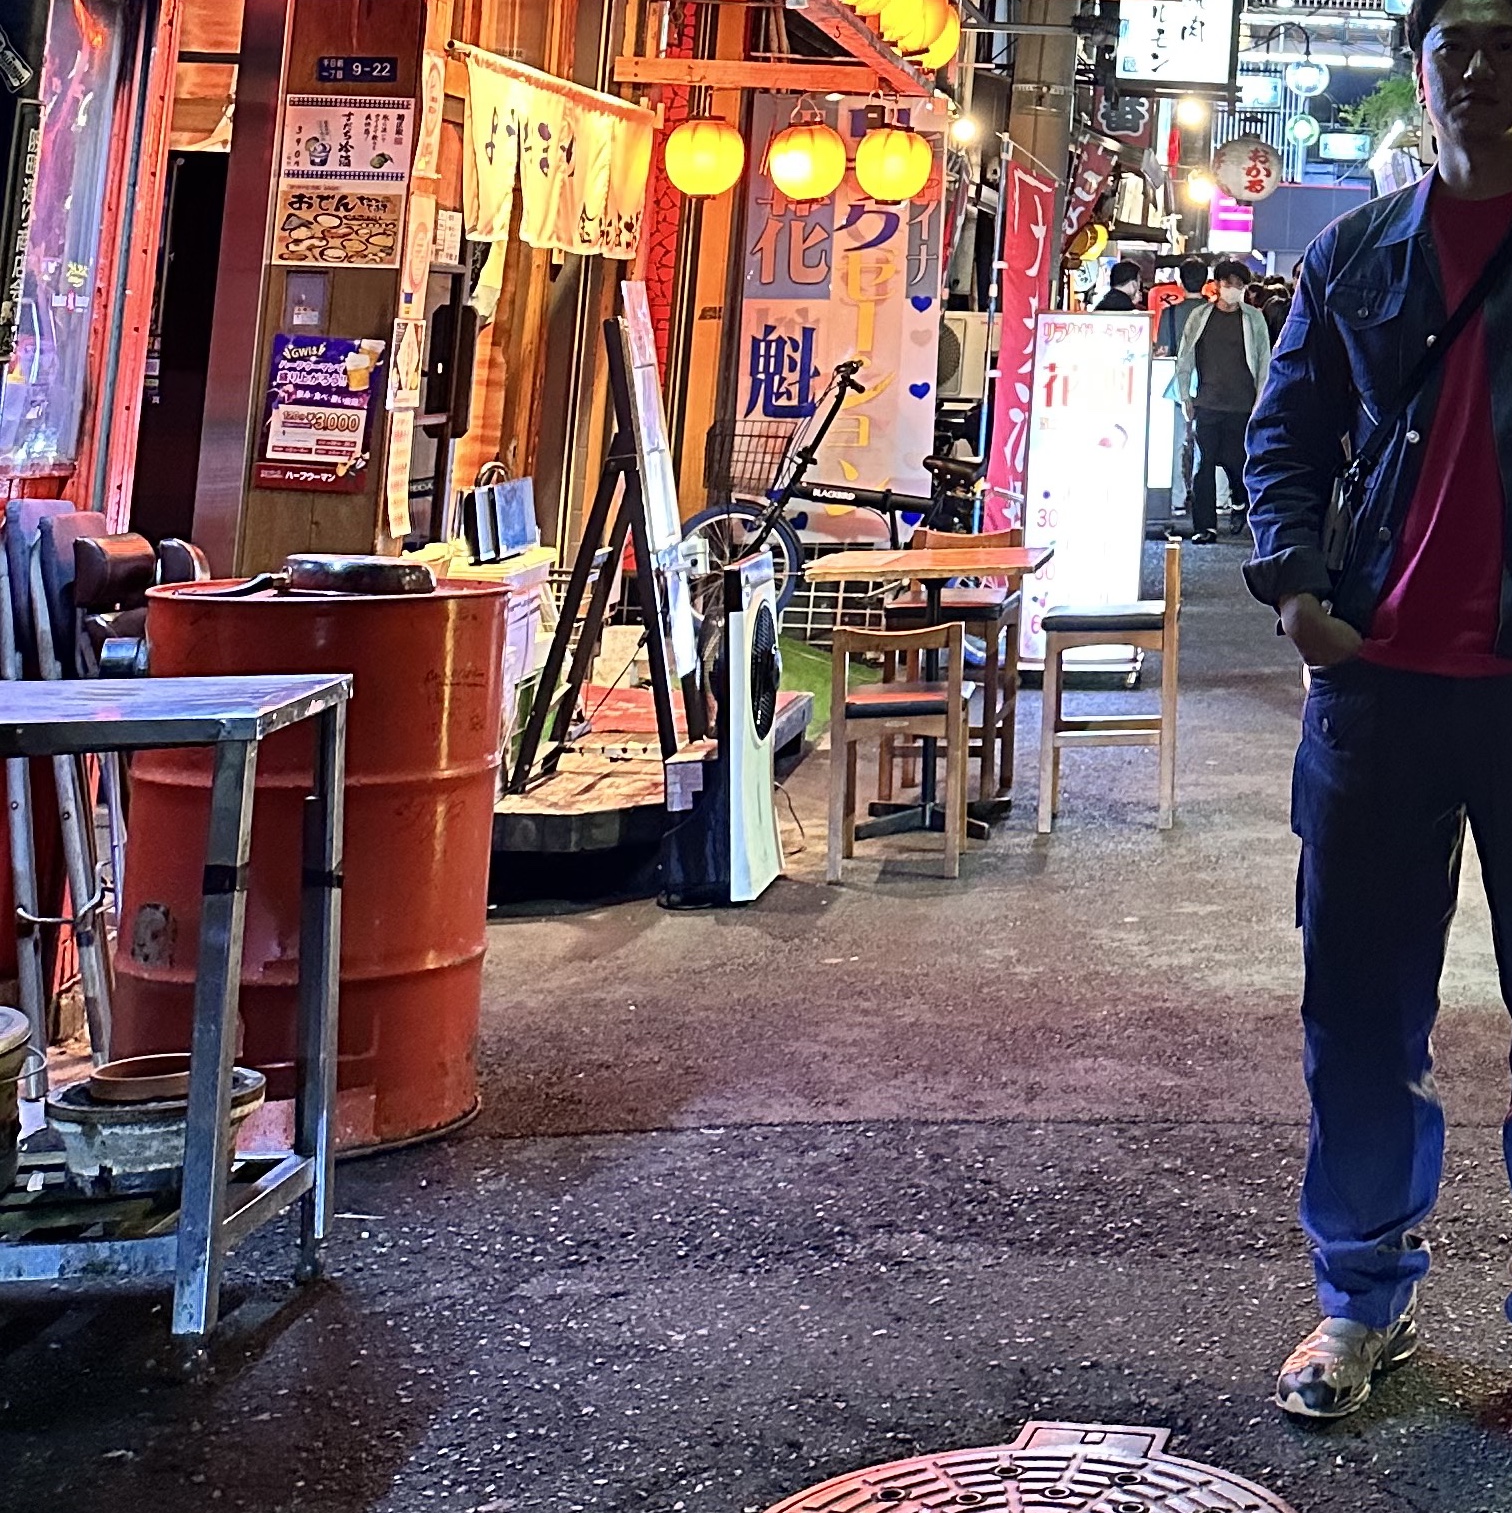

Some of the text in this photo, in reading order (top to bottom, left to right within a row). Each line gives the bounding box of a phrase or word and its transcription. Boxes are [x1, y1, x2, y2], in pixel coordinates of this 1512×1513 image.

[1150, 3, 1170, 74] ルモン
[351, 61, 392, 77] 9-22
[288, 192, 357, 213] おでん
